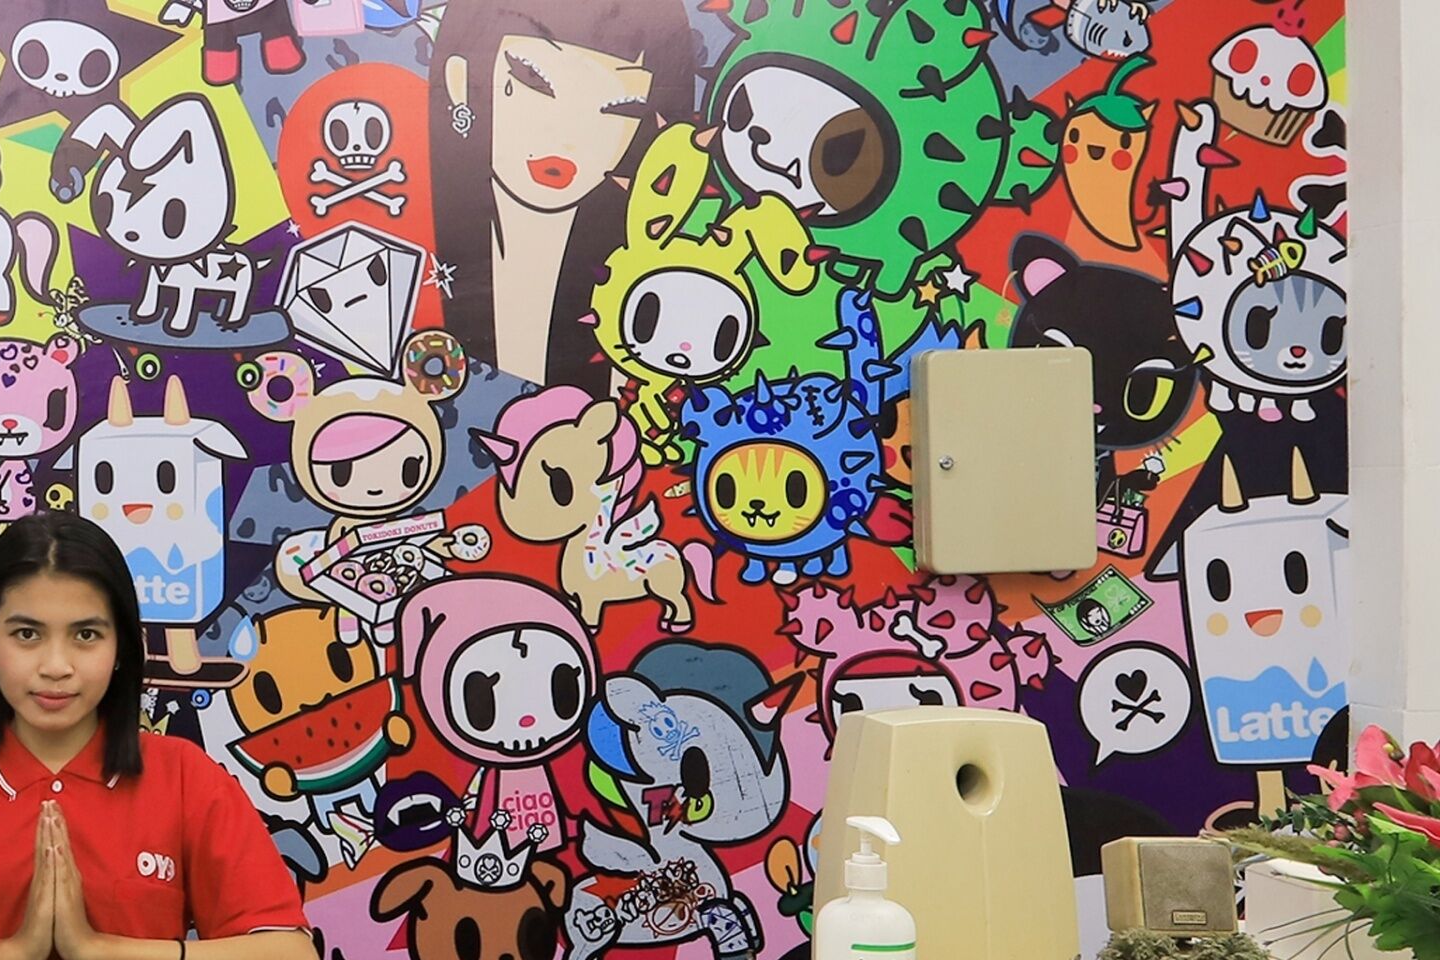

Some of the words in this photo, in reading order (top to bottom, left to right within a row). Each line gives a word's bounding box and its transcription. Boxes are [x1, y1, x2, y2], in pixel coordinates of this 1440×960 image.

[361, 526, 403, 543] TOKIDOKI
[404, 520, 439, 538] DONUTS
[134, 575, 190, 605] tte
[1216, 701, 1337, 743] Latte
[502, 790, 554, 812] ciao
[506, 810, 556, 831] ciao
